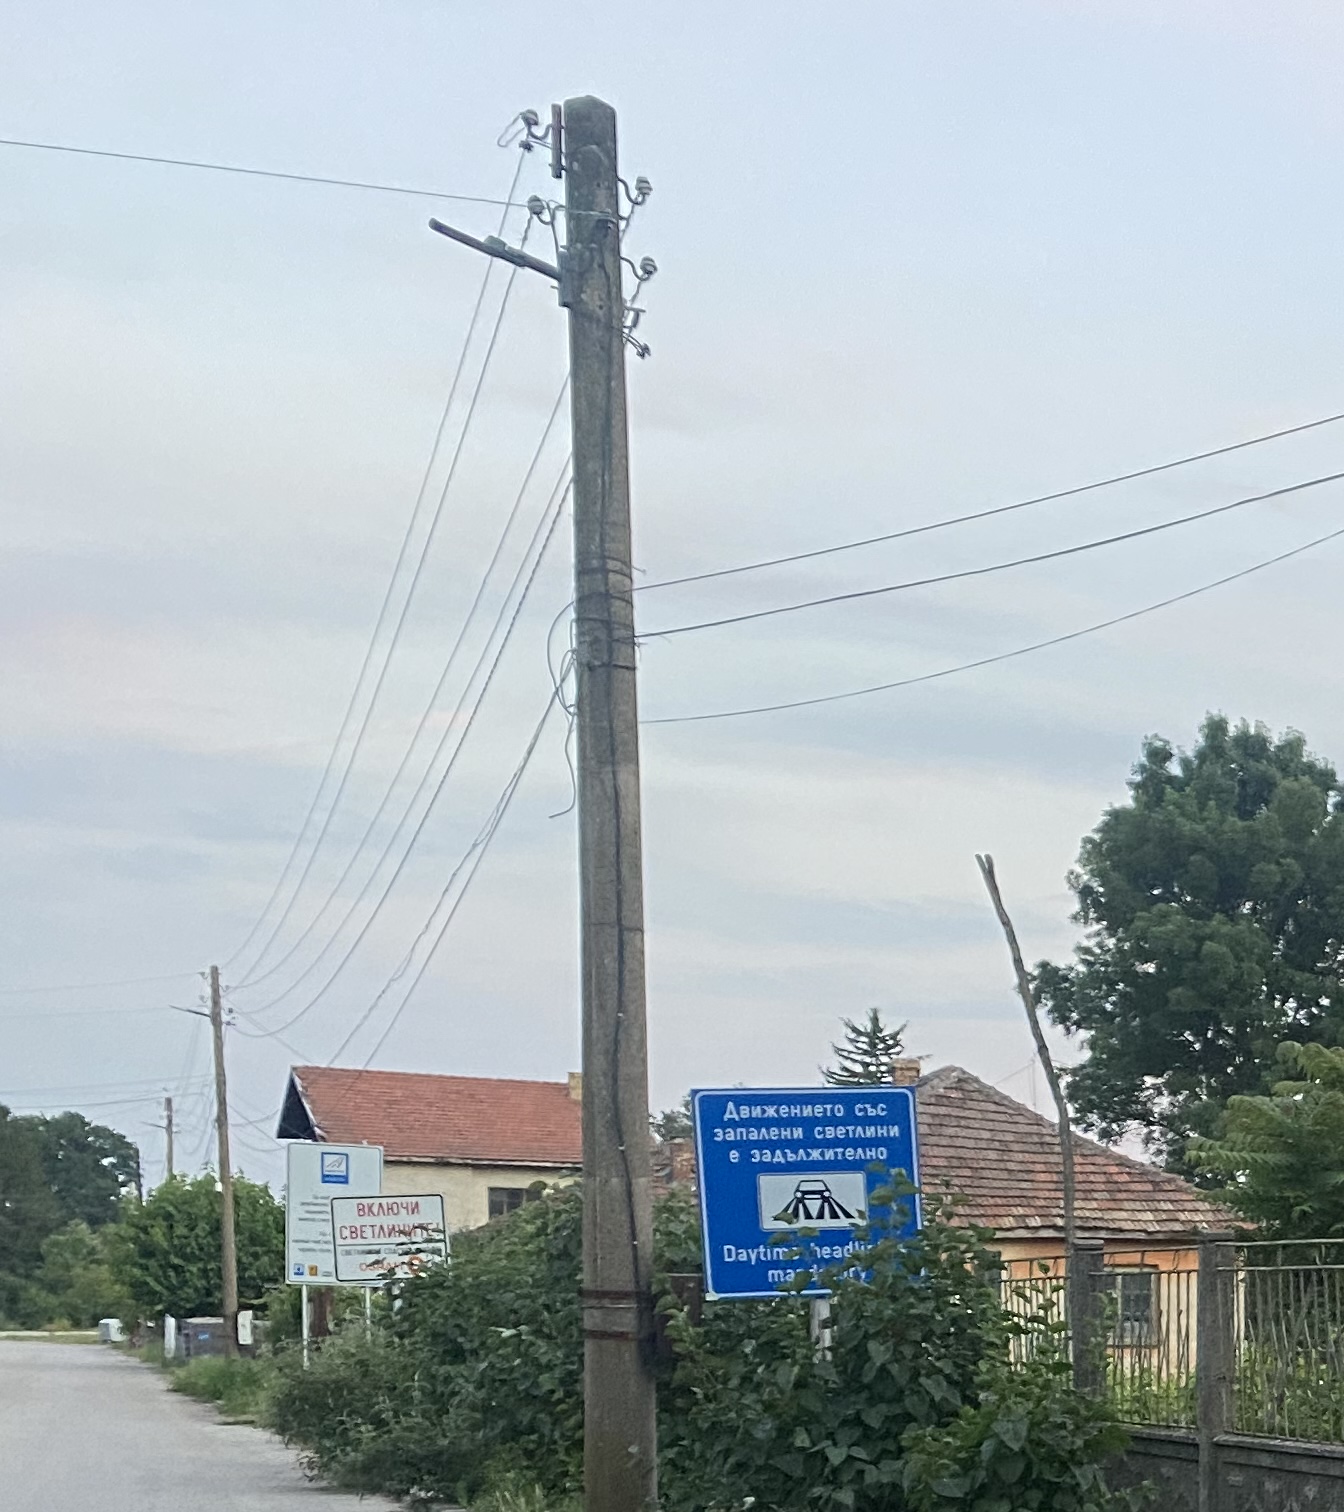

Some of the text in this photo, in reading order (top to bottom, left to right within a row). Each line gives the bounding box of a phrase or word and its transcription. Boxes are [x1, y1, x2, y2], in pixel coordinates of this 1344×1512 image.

[723, 1101, 888, 1121] Движението със
[713, 1124, 900, 1142] запалени светлини
[729, 1147, 888, 1164] е задължително
[356, 1201, 421, 1217] ВКЛЮЧИ
